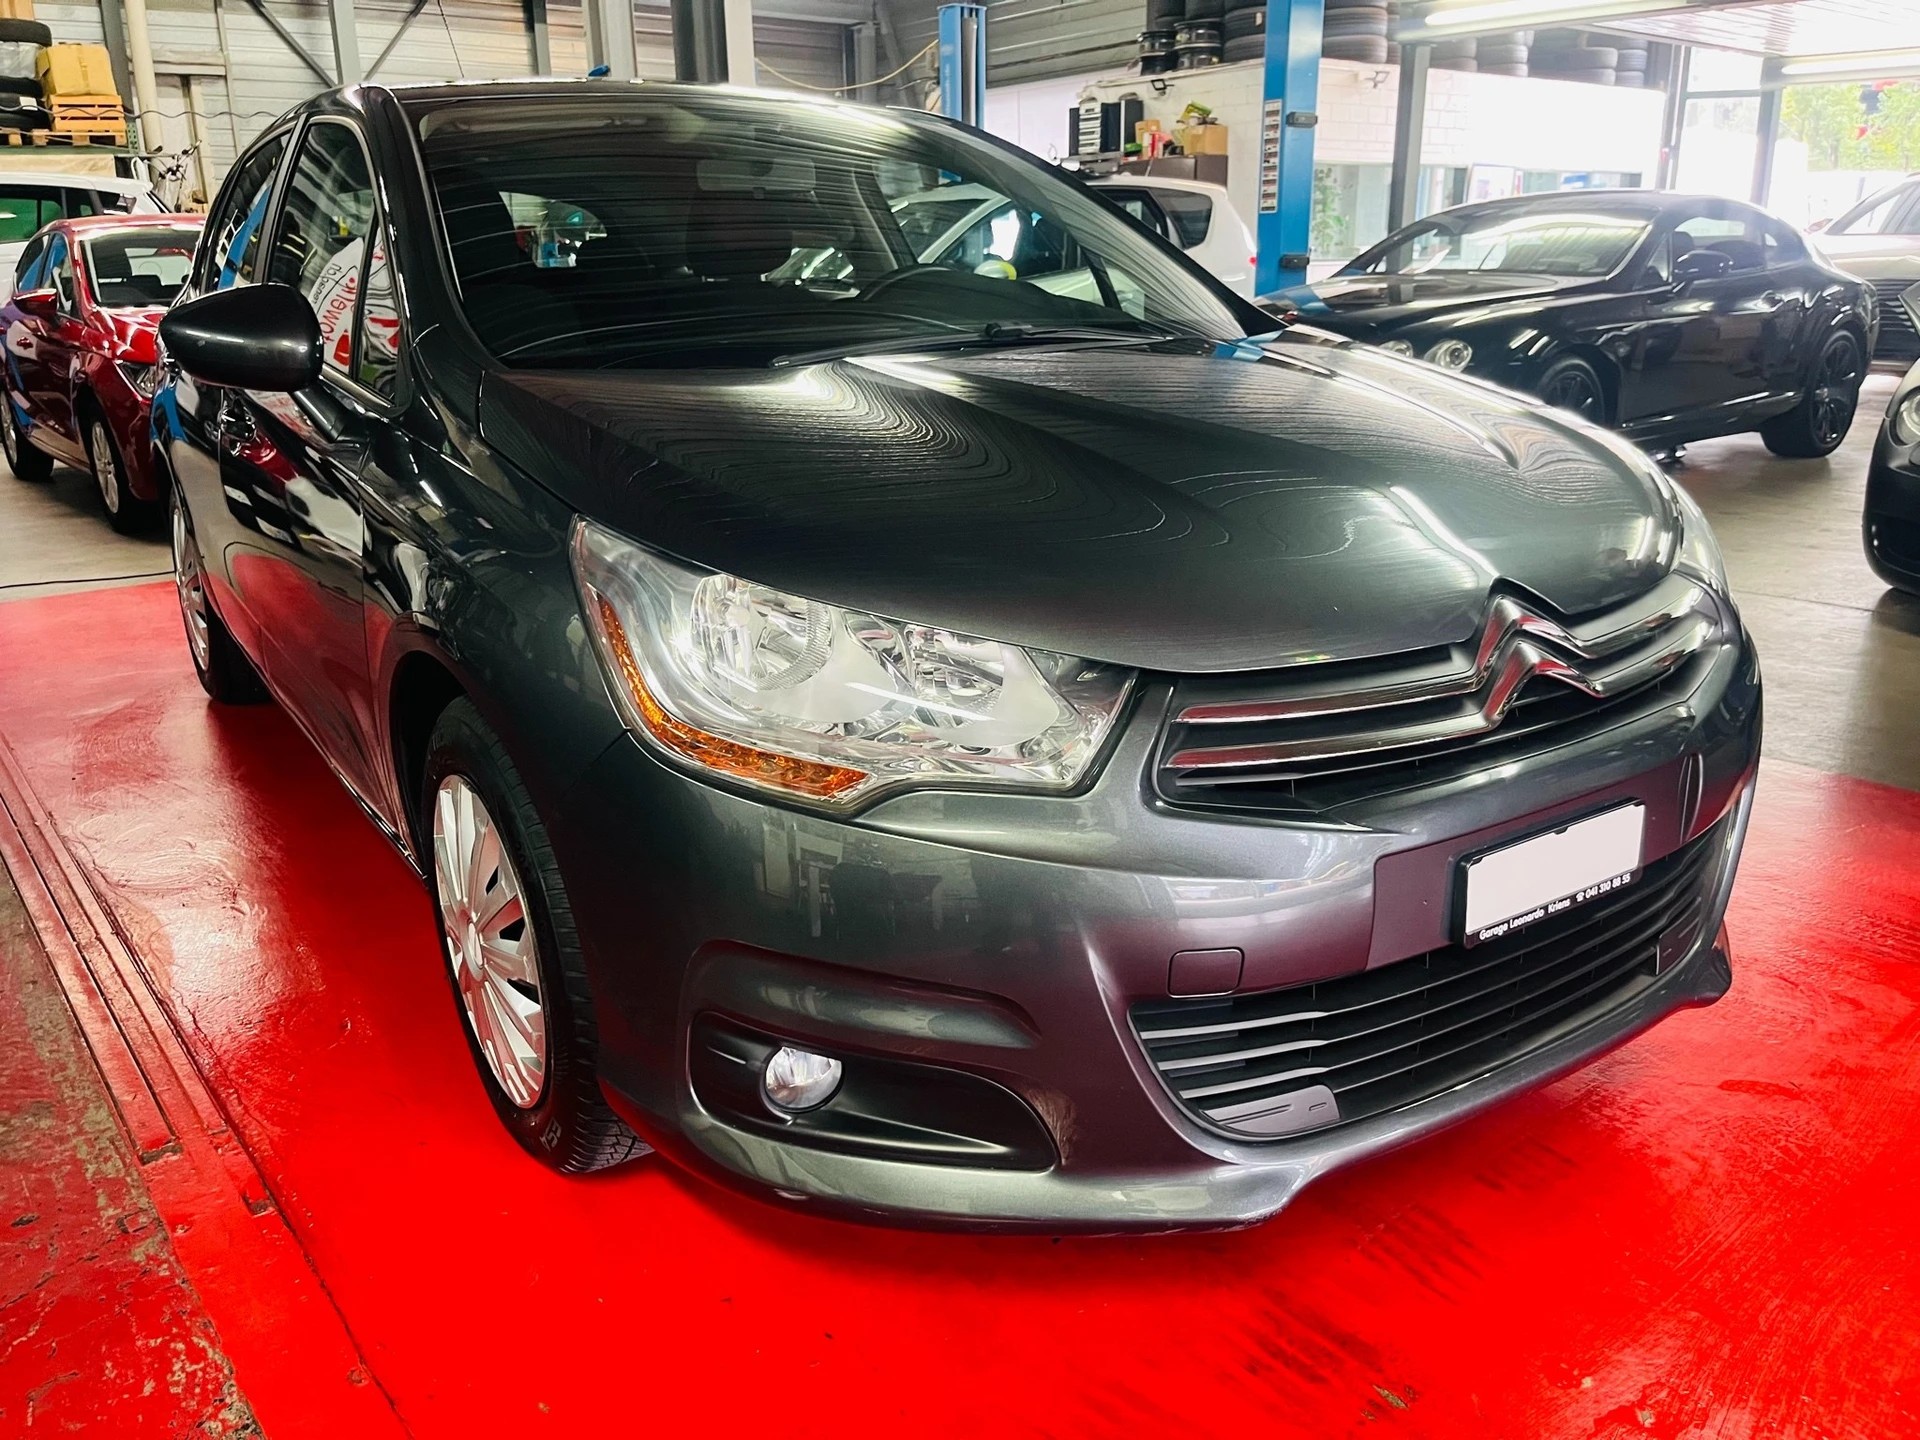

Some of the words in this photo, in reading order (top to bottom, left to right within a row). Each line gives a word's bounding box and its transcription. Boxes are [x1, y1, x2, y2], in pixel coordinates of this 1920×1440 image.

[1479, 923, 1508, 940] Garage
[1510, 908, 1544, 928] Leonardo
[1548, 899, 1570, 913] Kriens
[1585, 885, 1598, 898] 041
[1599, 881, 1611, 893] 310
